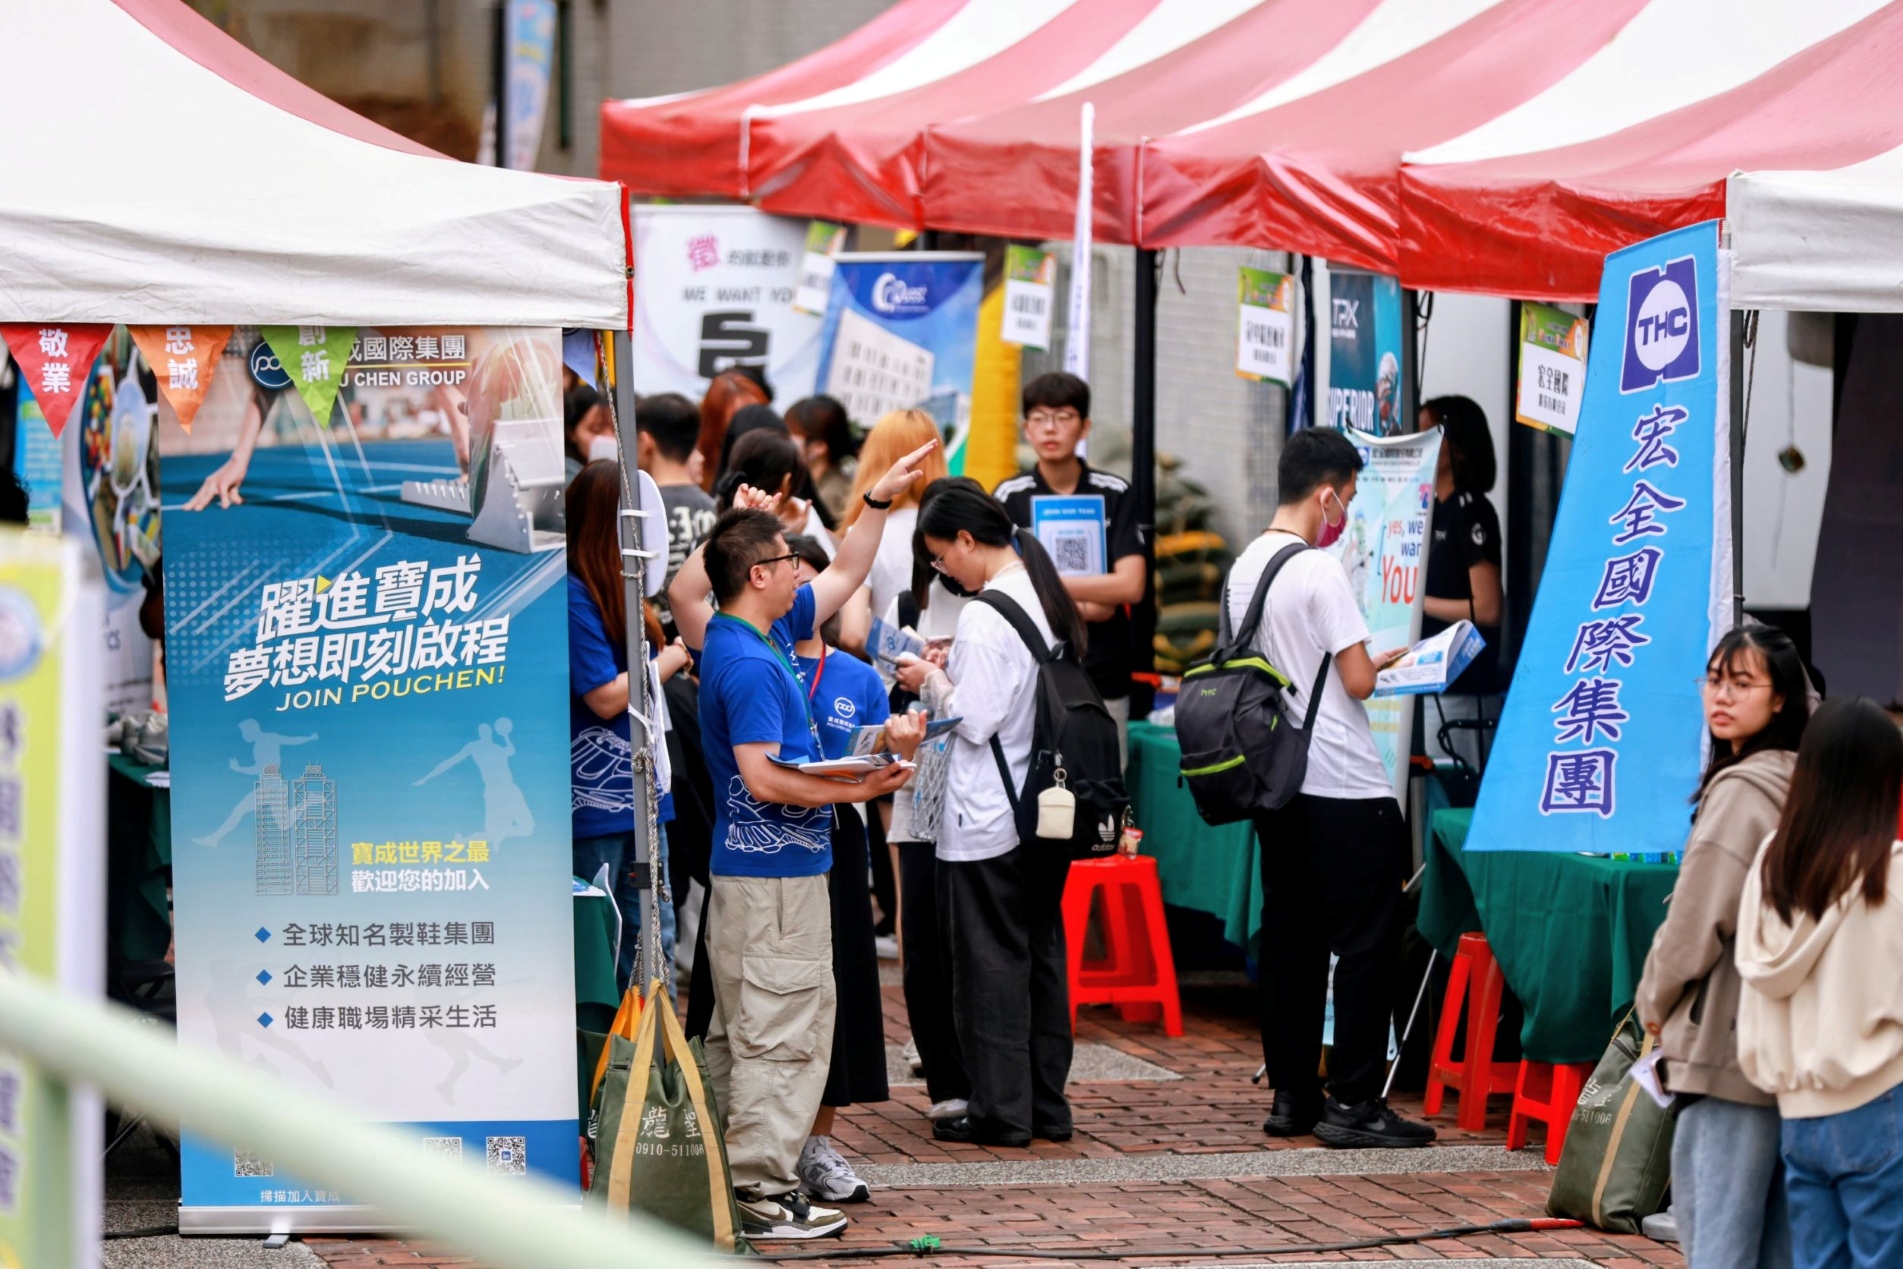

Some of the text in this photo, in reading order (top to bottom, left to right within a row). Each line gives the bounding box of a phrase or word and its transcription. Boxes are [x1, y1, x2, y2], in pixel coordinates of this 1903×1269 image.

[717, 285, 762, 302] WANT
[771, 286, 794, 301] YO
[1638, 307, 1689, 346] THC
[39, 328, 71, 393] 敬業
[165, 326, 198, 390] 忠誠
[299, 325, 330, 383] 創新
[350, 335, 466, 362] 成國際集團
[354, 372, 401, 387] CHEN
[406, 370, 466, 386] GROUP
[1538, 364, 1569, 397] 宏全國際
[1408, 520, 1424, 535] we
[1382, 555, 1419, 605] You
[256, 552, 482, 643] 躍進寶成
[1541, 406, 1687, 817] 宏全國際集團
[223, 612, 510, 702] 夢想即刻啟程
[275, 665, 506, 712] JOIN POUCHEN!
[351, 840, 490, 865] 寶成世界之最
[351, 868, 490, 893] 歡迎您的加入
[282, 921, 495, 947] 全球知名製鞋集團
[283, 963, 496, 988] 企業穩健永續經營
[284, 1004, 497, 1030] 健康職場精采生活
